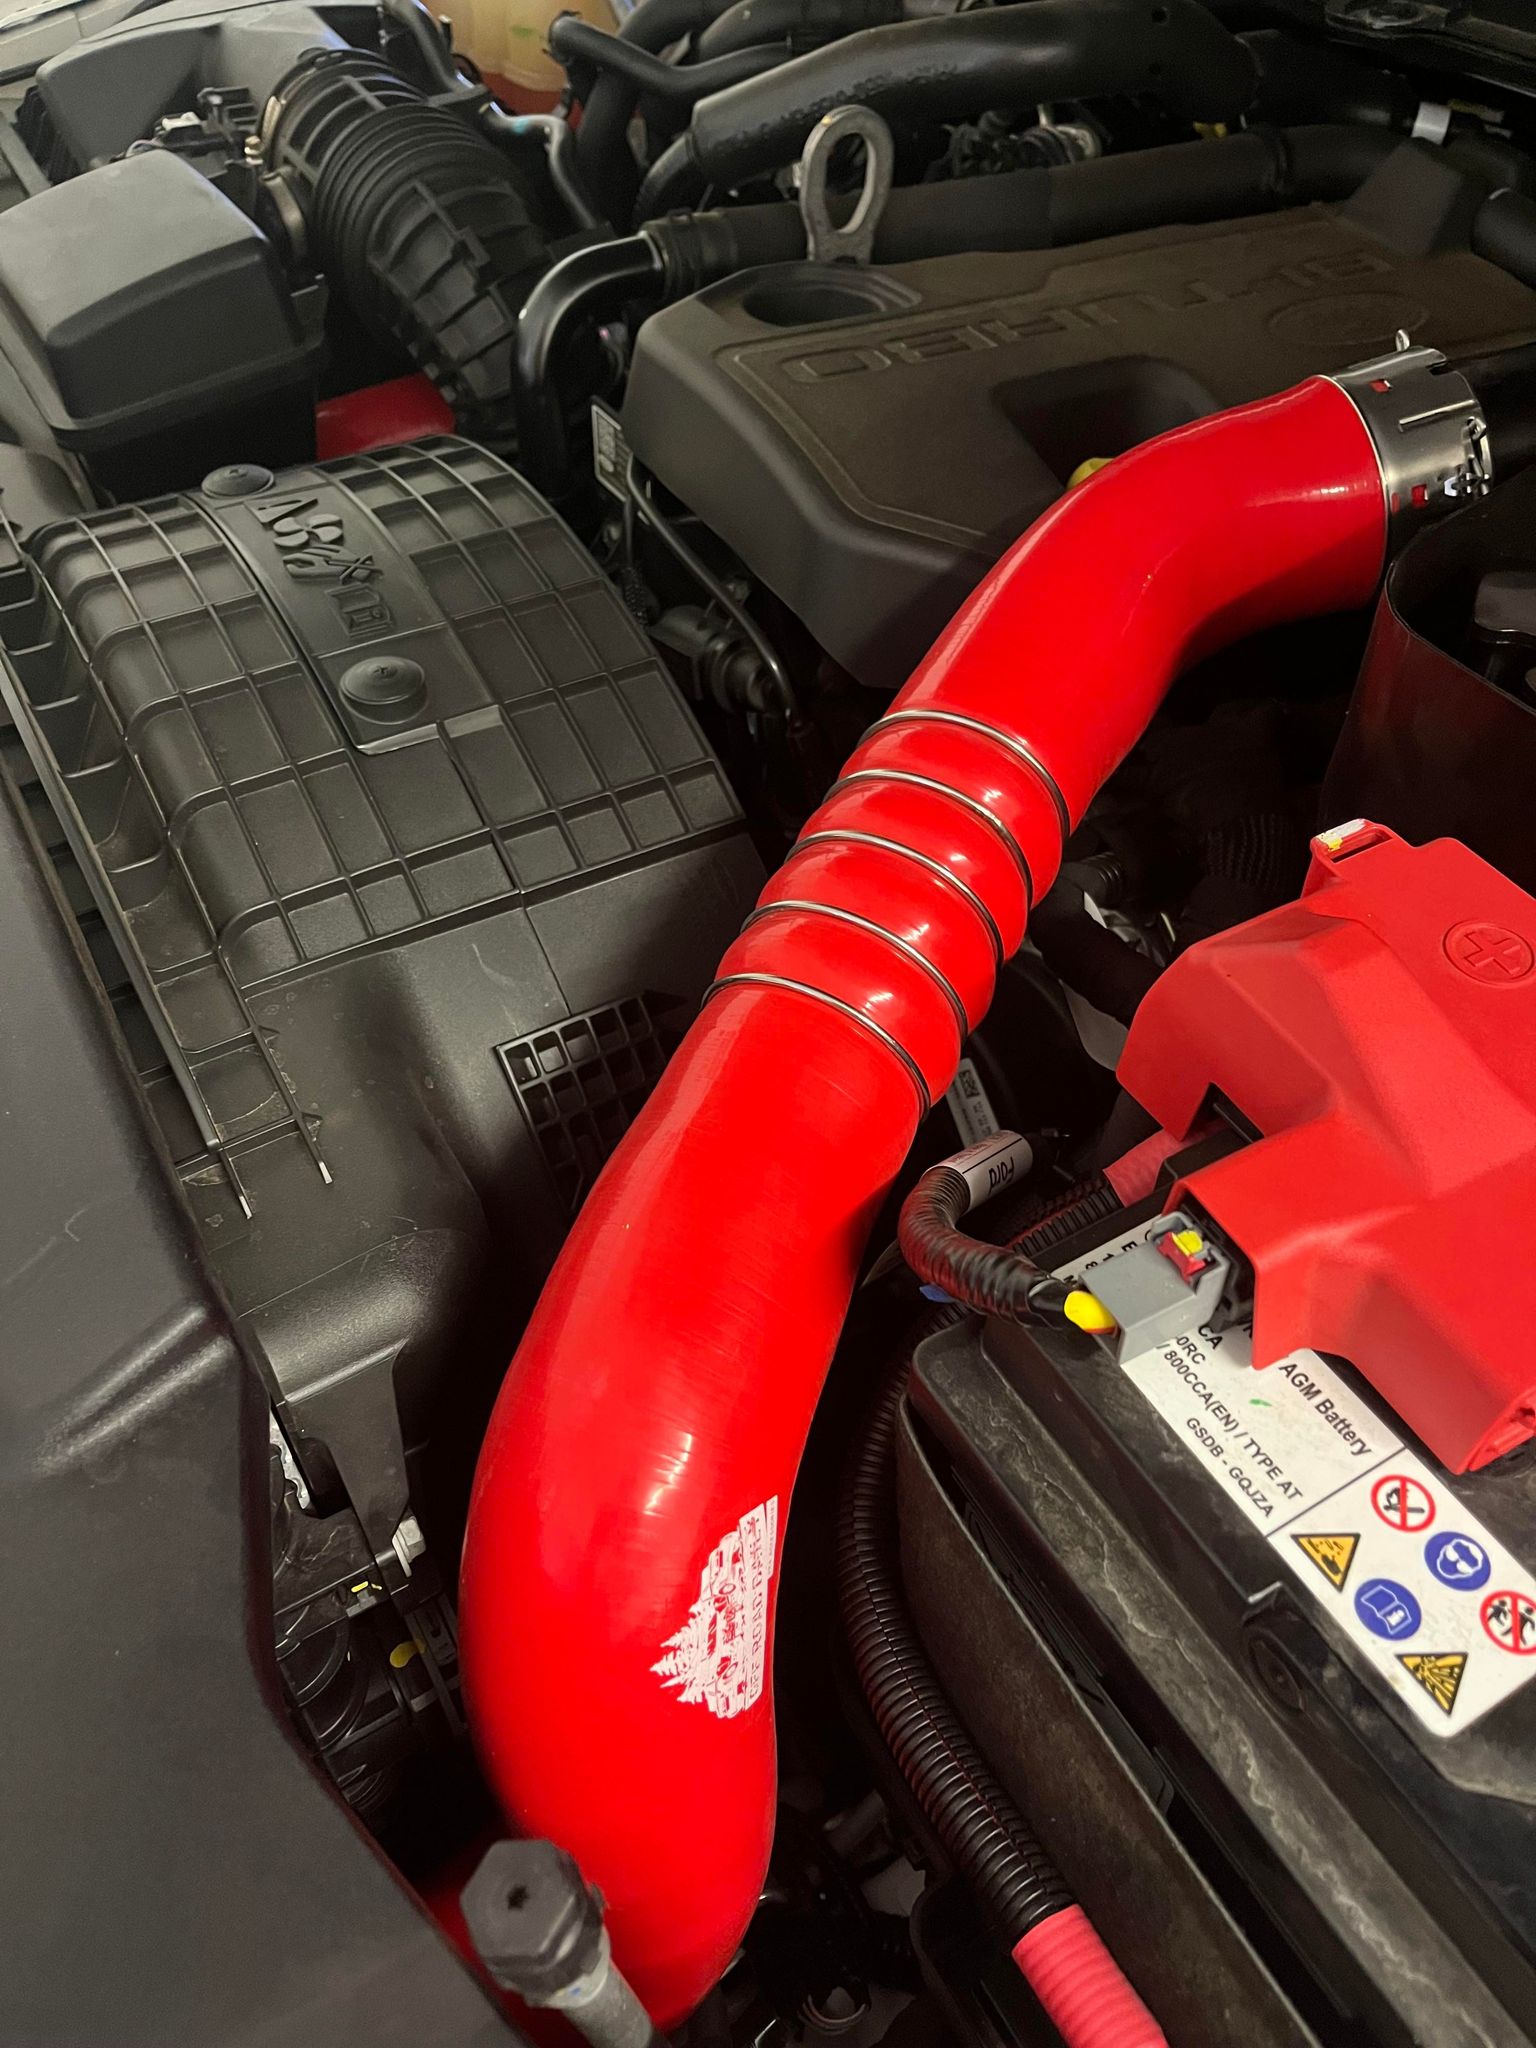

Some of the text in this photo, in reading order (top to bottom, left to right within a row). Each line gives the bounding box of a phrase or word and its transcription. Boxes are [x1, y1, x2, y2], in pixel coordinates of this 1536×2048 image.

[988, 1156, 1015, 1193] Ford
[1176, 1336, 1206, 1364] 0RC
[1164, 1350, 1239, 1432] 800CCA(EN)
[1244, 1438, 1283, 1480] TYPE
[1277, 1481, 1303, 1499] AT
[1278, 1364, 1372, 1456] AGM Battery
[1187, 1418, 1224, 1457] GSDB
[1229, 1467, 1273, 1518] GQJZA
